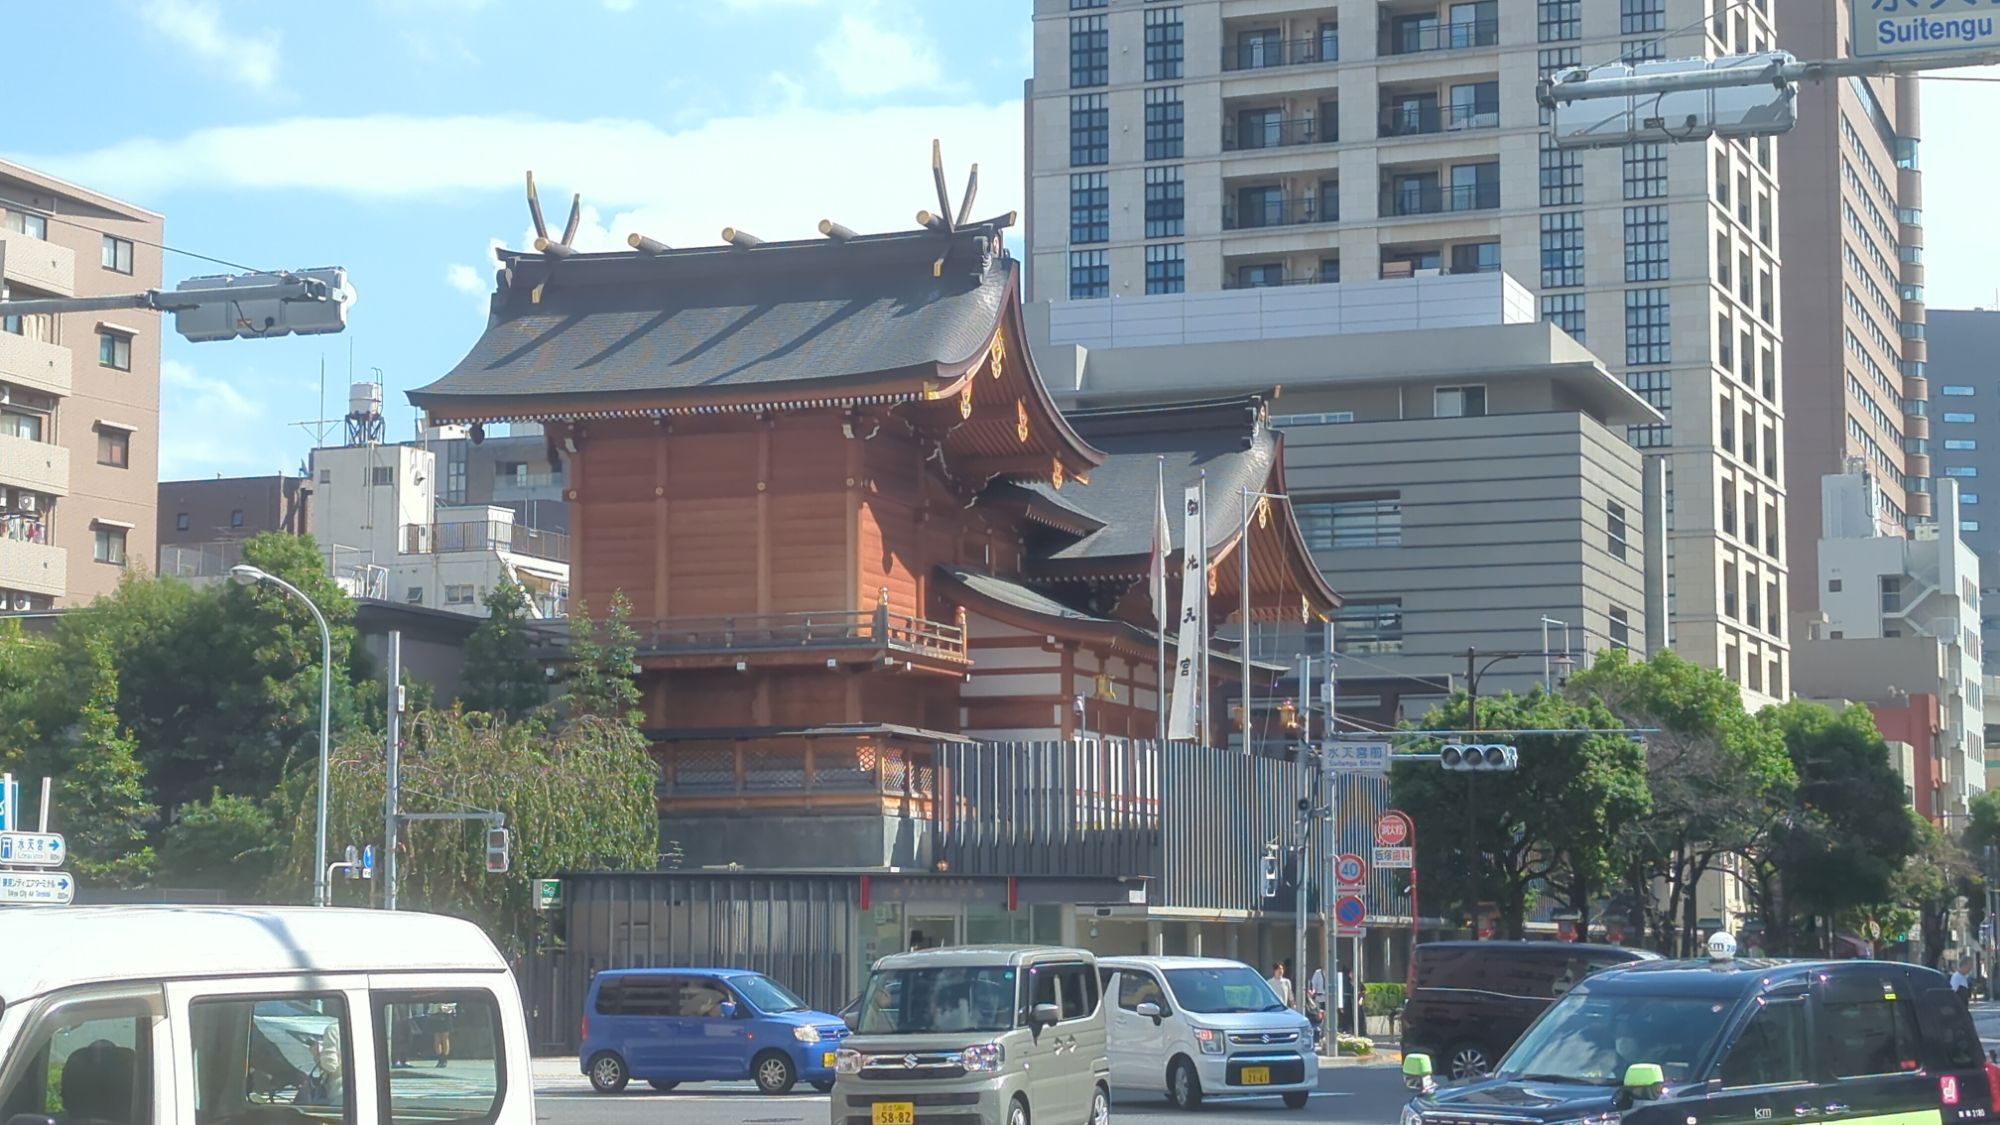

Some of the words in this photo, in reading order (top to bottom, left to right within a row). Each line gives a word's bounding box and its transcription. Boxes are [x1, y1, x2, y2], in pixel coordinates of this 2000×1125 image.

[1878, 17, 1993, 45] Suitengu
[1328, 746, 1382, 759] 水天宮前
[1341, 862, 1359, 877] 40
